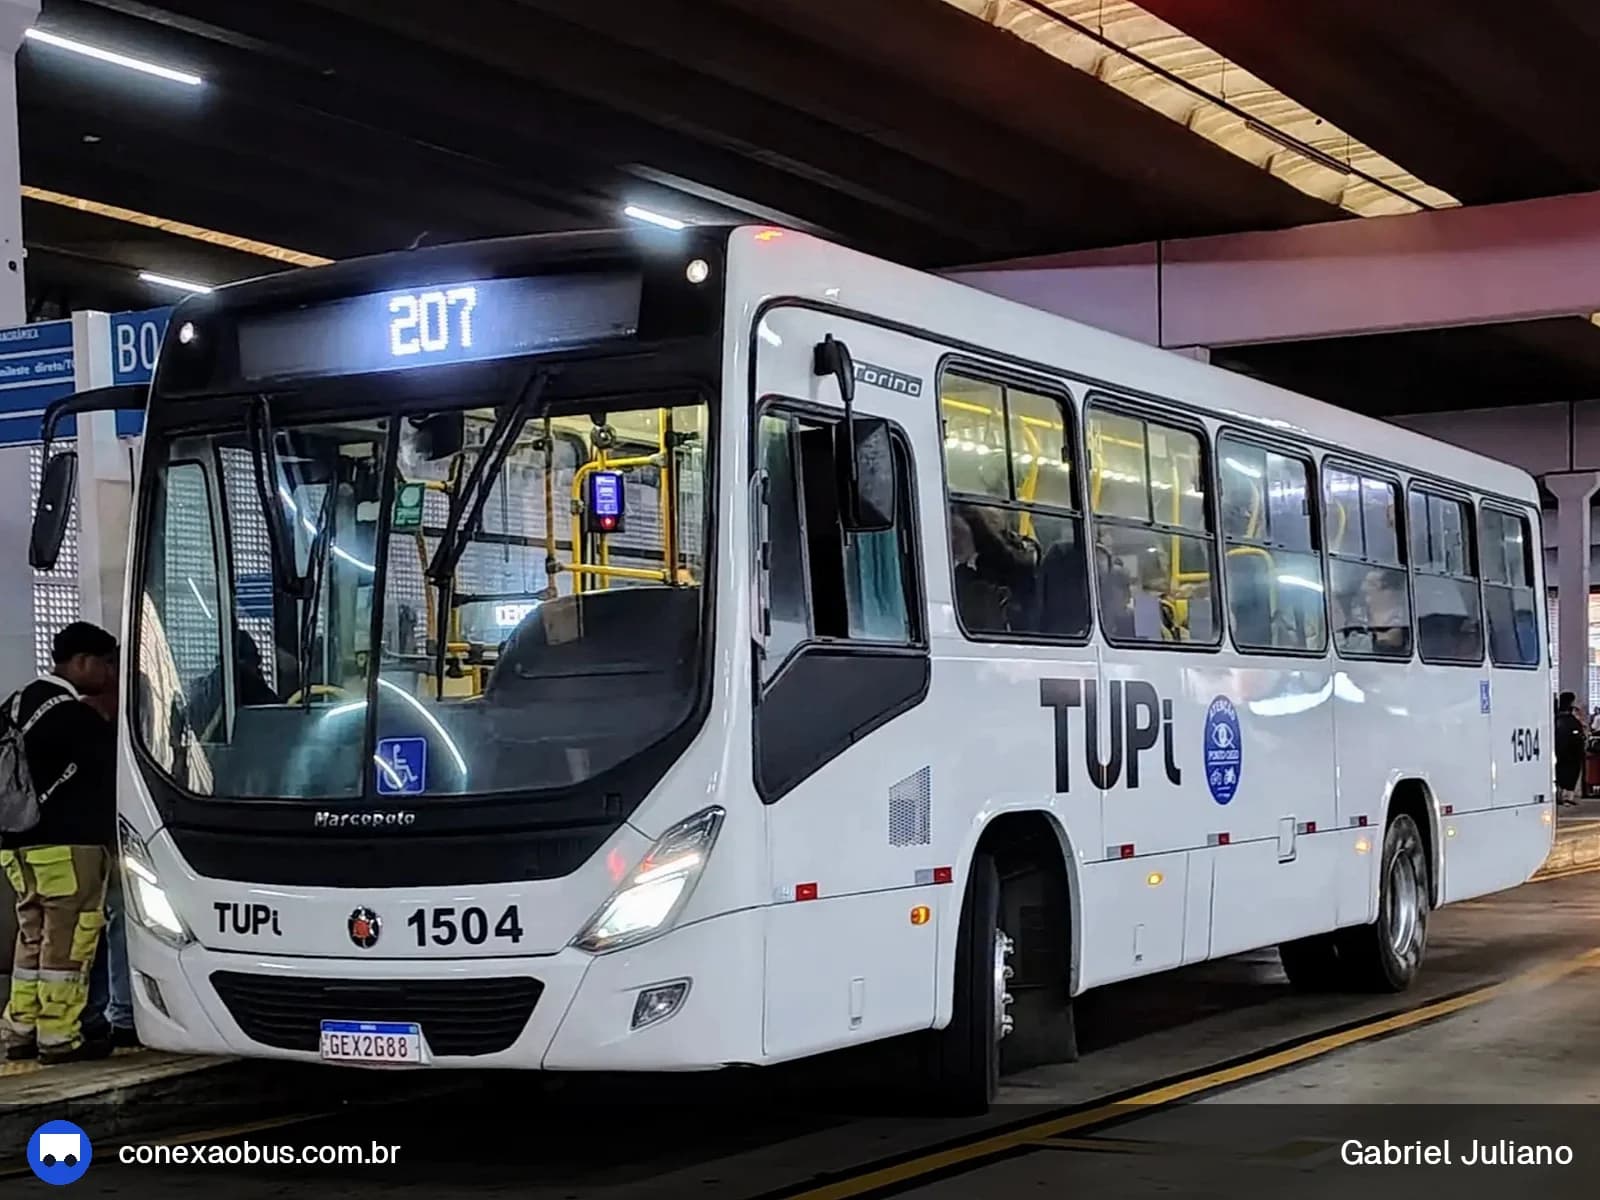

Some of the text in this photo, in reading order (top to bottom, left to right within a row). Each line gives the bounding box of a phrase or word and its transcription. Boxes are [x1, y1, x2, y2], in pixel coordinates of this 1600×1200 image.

[389, 286, 477, 356] 207
[117, 320, 169, 373] BO
[852, 362, 920, 395] Torino
[1040, 678, 1181, 793] TUPi
[1511, 728, 1540, 763] 1504
[314, 810, 416, 827] Marcopolo
[213, 902, 282, 936] TUPi
[407, 905, 523, 947] 1504
[330, 1034, 408, 1058] GEX2G88
